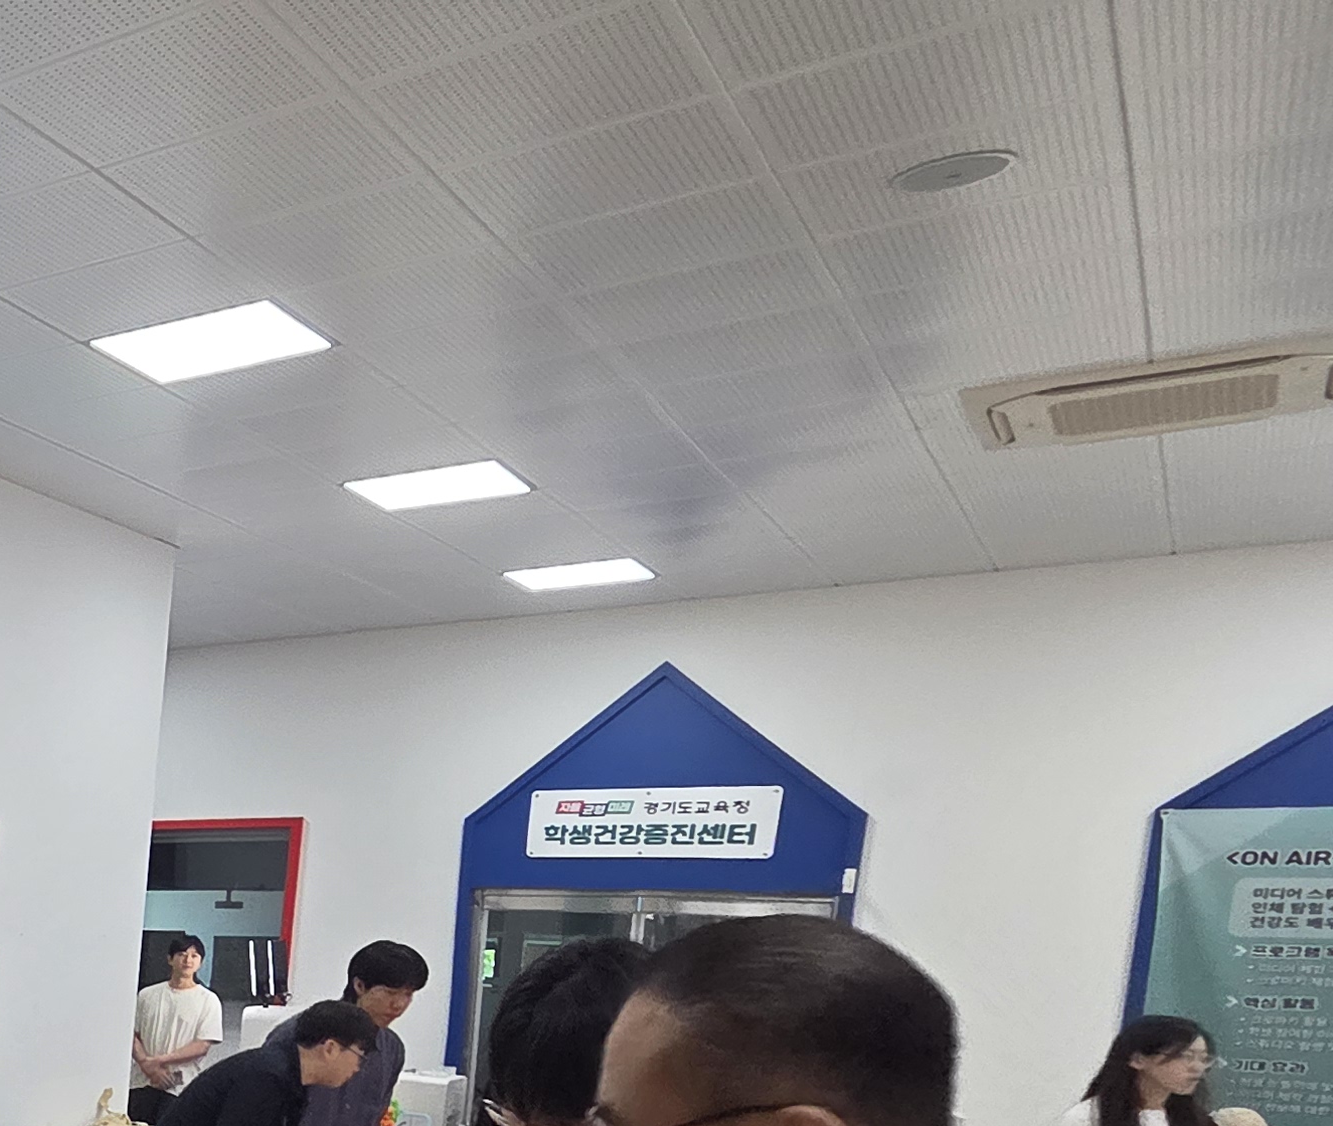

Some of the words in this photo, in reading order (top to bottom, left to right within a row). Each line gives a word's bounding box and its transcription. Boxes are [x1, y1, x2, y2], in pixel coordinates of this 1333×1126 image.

[644, 800, 750, 814] 경기도교육청
[544, 823, 757, 845] 학생건강증진센터
[1285, 850, 1332, 866] AIR
[1252, 887, 1303, 899] 미디어
